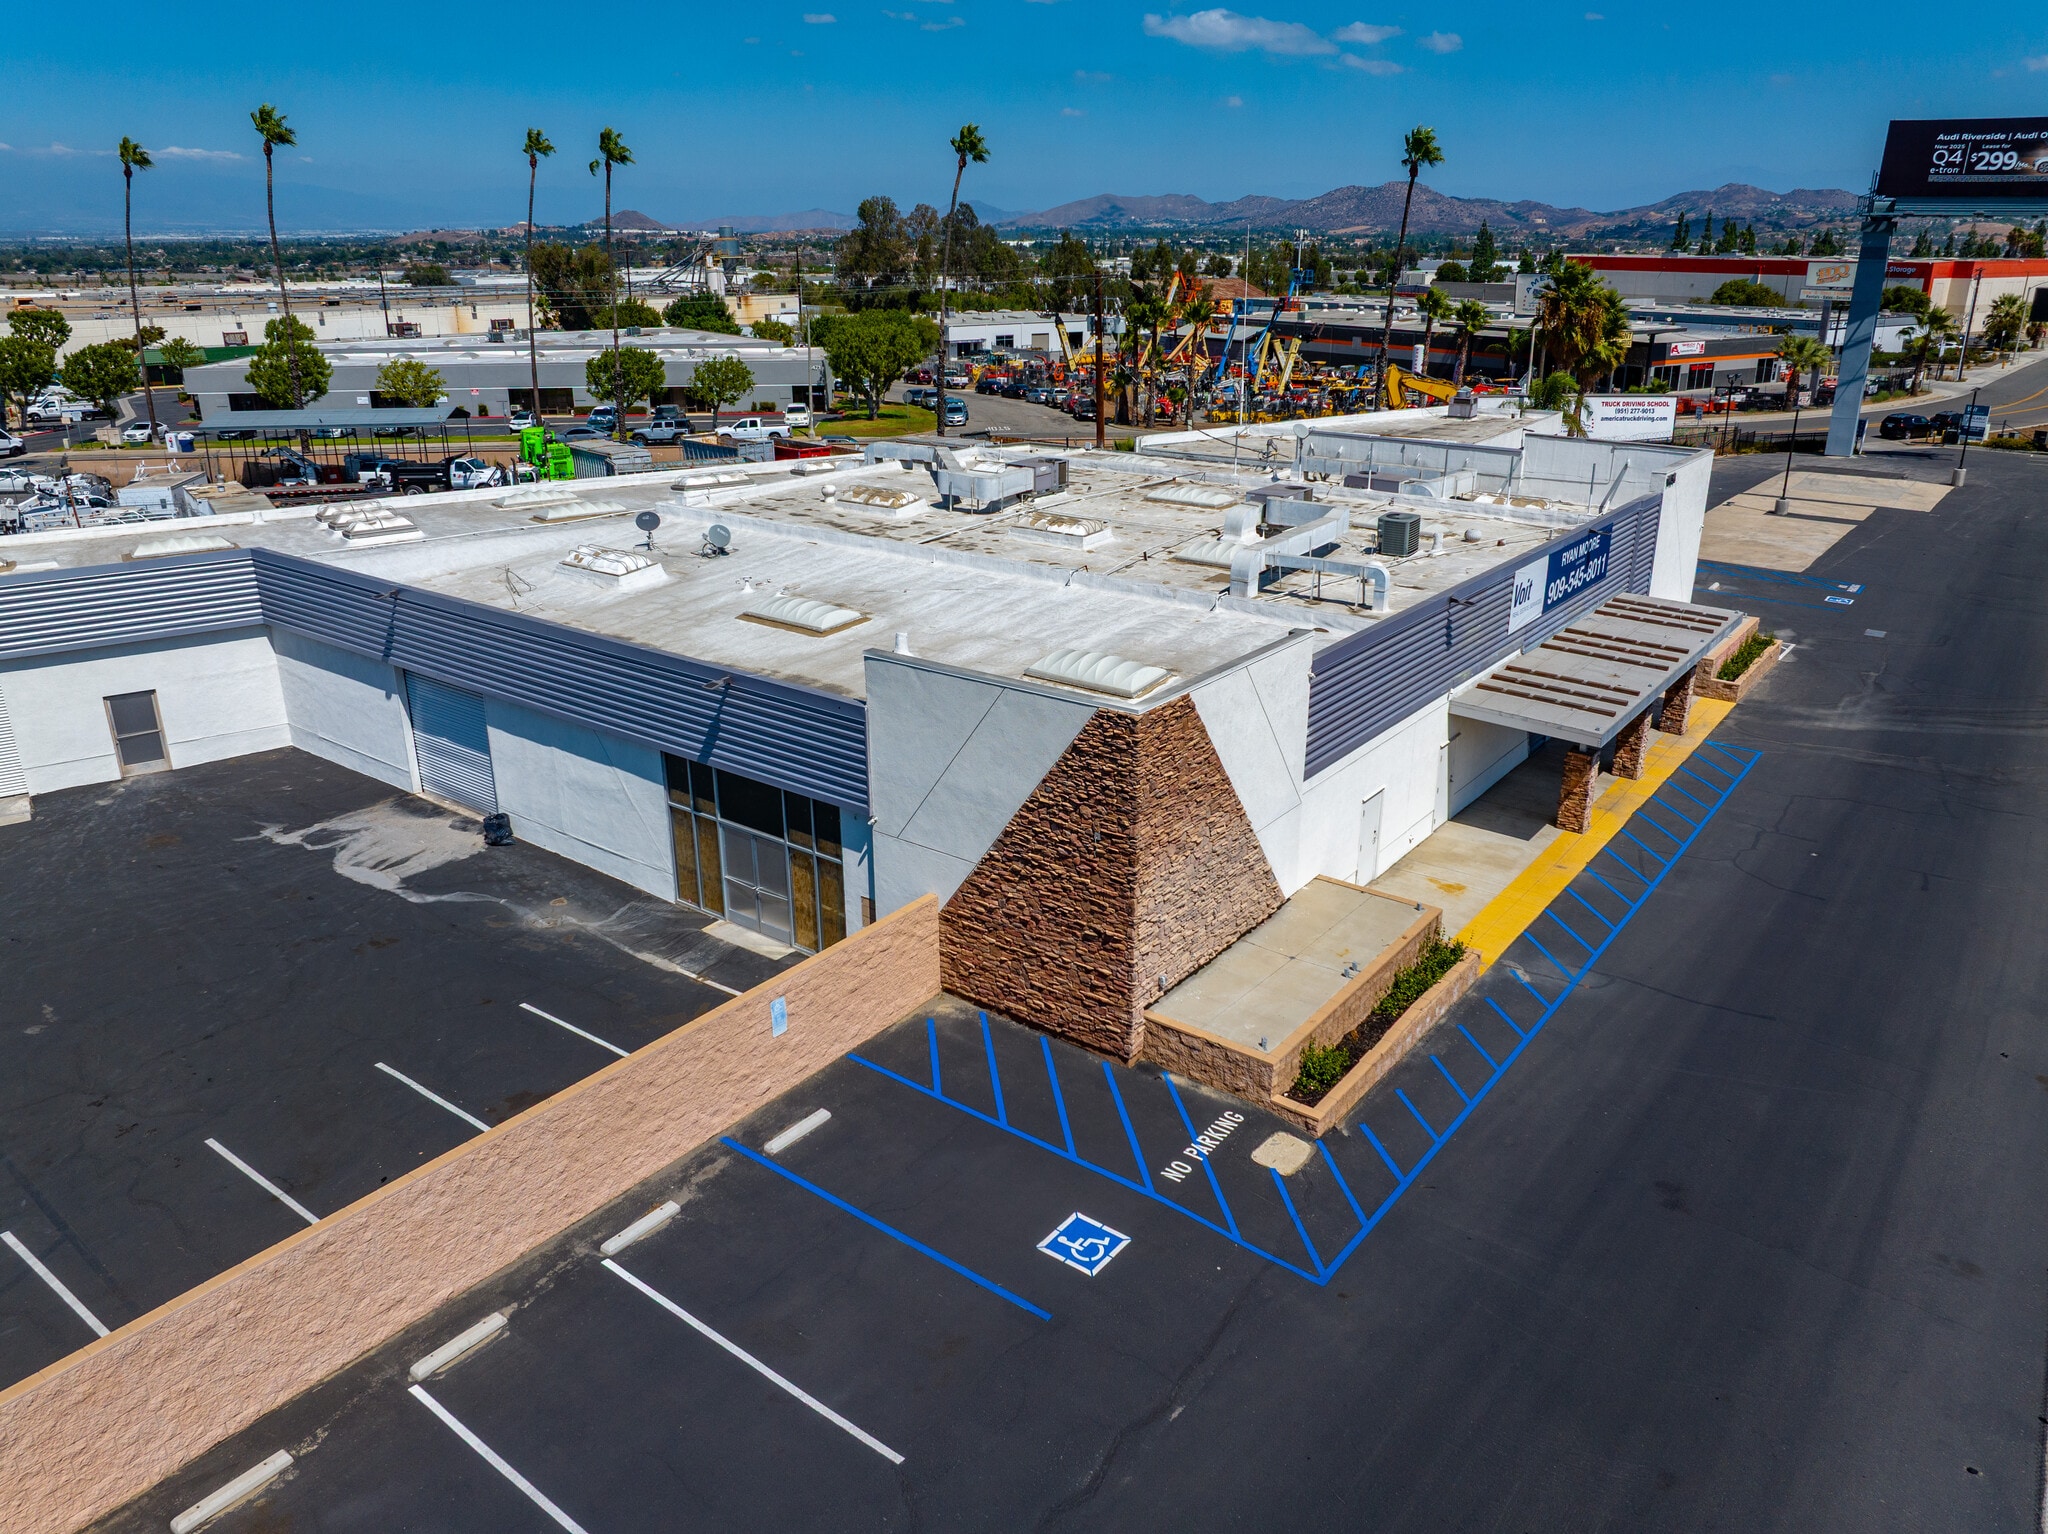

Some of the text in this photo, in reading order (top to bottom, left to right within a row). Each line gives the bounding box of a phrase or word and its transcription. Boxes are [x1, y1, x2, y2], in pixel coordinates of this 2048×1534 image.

[1937, 133, 1960, 141] Audi
[1961, 132, 2006, 140] Riverside
[2014, 131, 2038, 140] Audi
[1932, 150, 1963, 166] Q4
[1970, 151, 2019, 171] $299
[1929, 166, 1959, 174] e-tron
[1890, 266, 1917, 274] Storage
[1561, 535, 1601, 567] RYAN MOORE
[1547, 553, 1607, 604] 909-545-8011
[1513, 578, 1533, 608] Voit
[1160, 1111, 1245, 1183] NO PARKING
